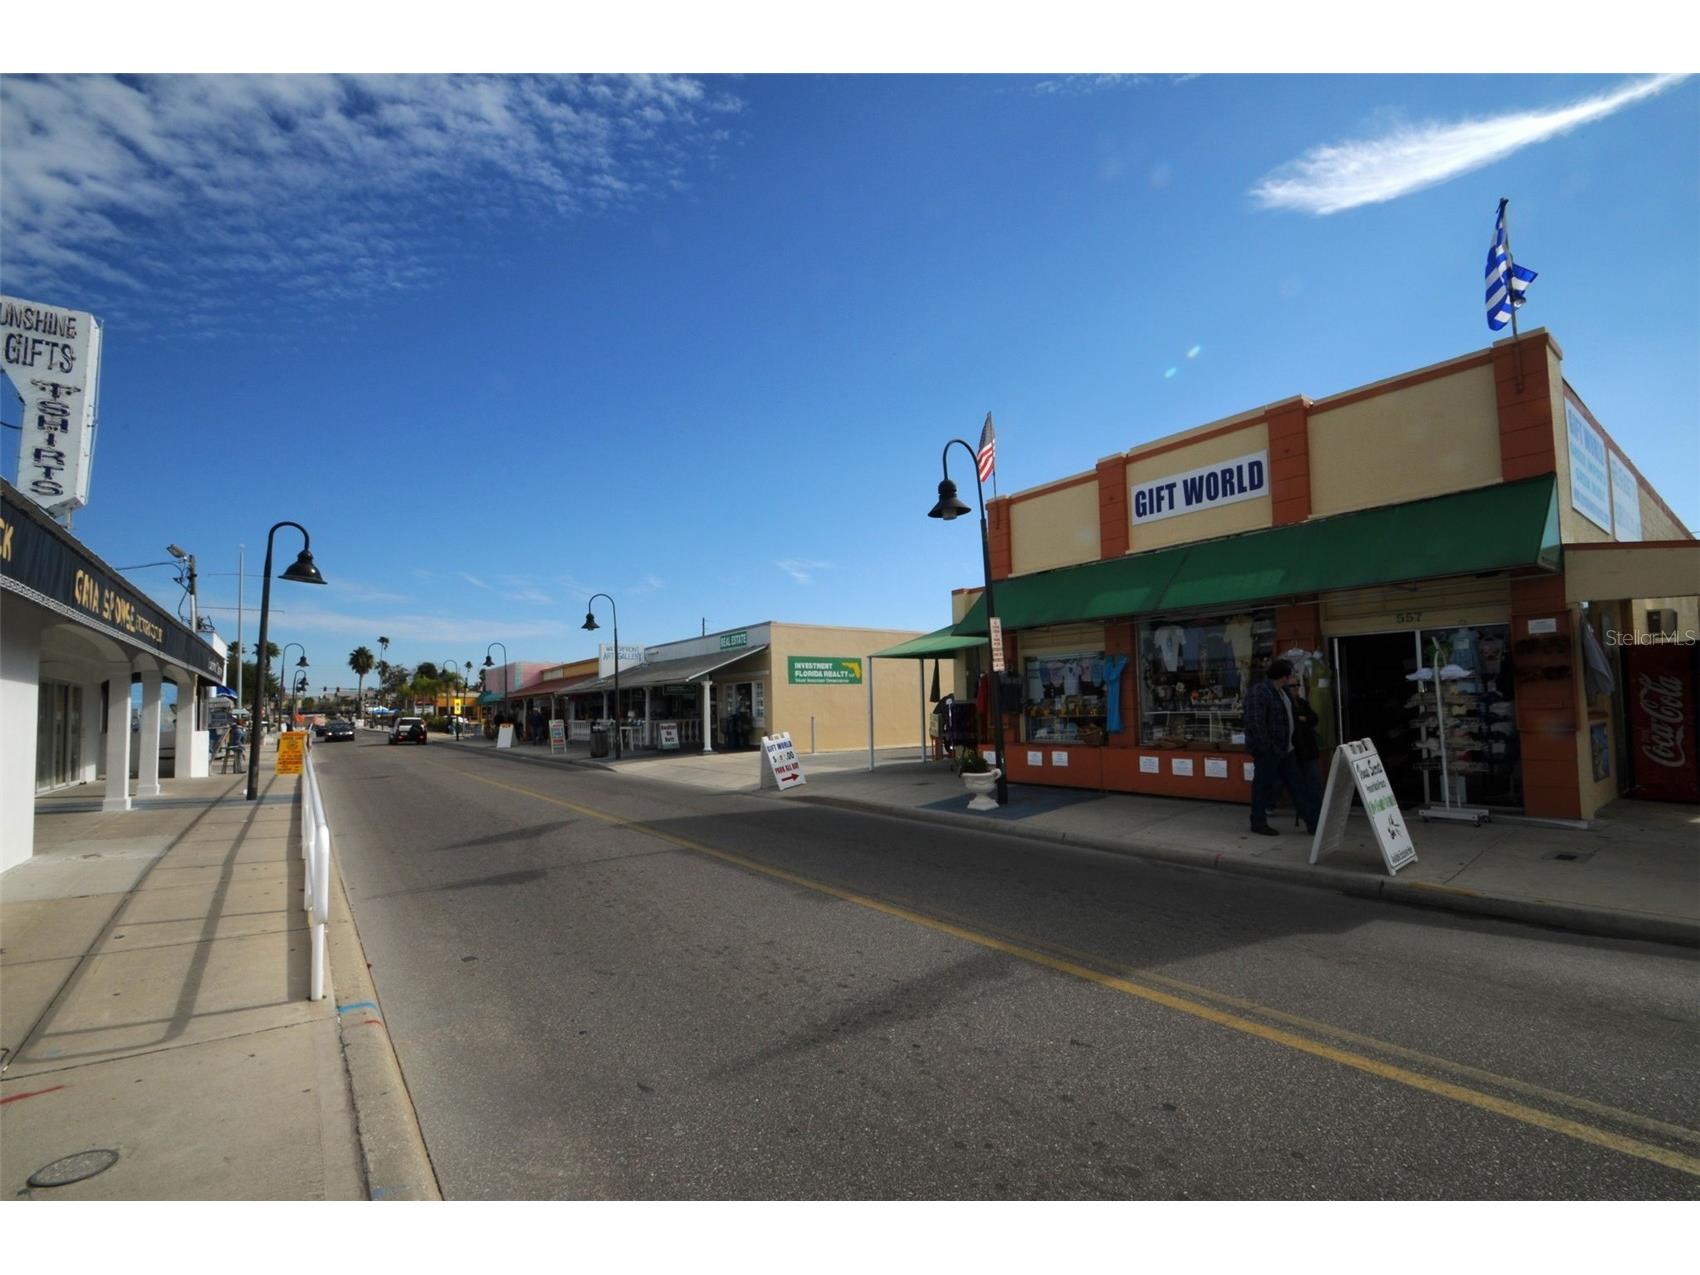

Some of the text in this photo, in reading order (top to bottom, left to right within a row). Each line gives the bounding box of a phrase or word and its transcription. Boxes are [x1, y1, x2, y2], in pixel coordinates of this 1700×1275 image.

[5, 333, 76, 374] GIFTS
[1135, 460, 1264, 518] GIFT WORLD
[74, 569, 99, 614] GAIA
[1396, 612, 1423, 624] 557
